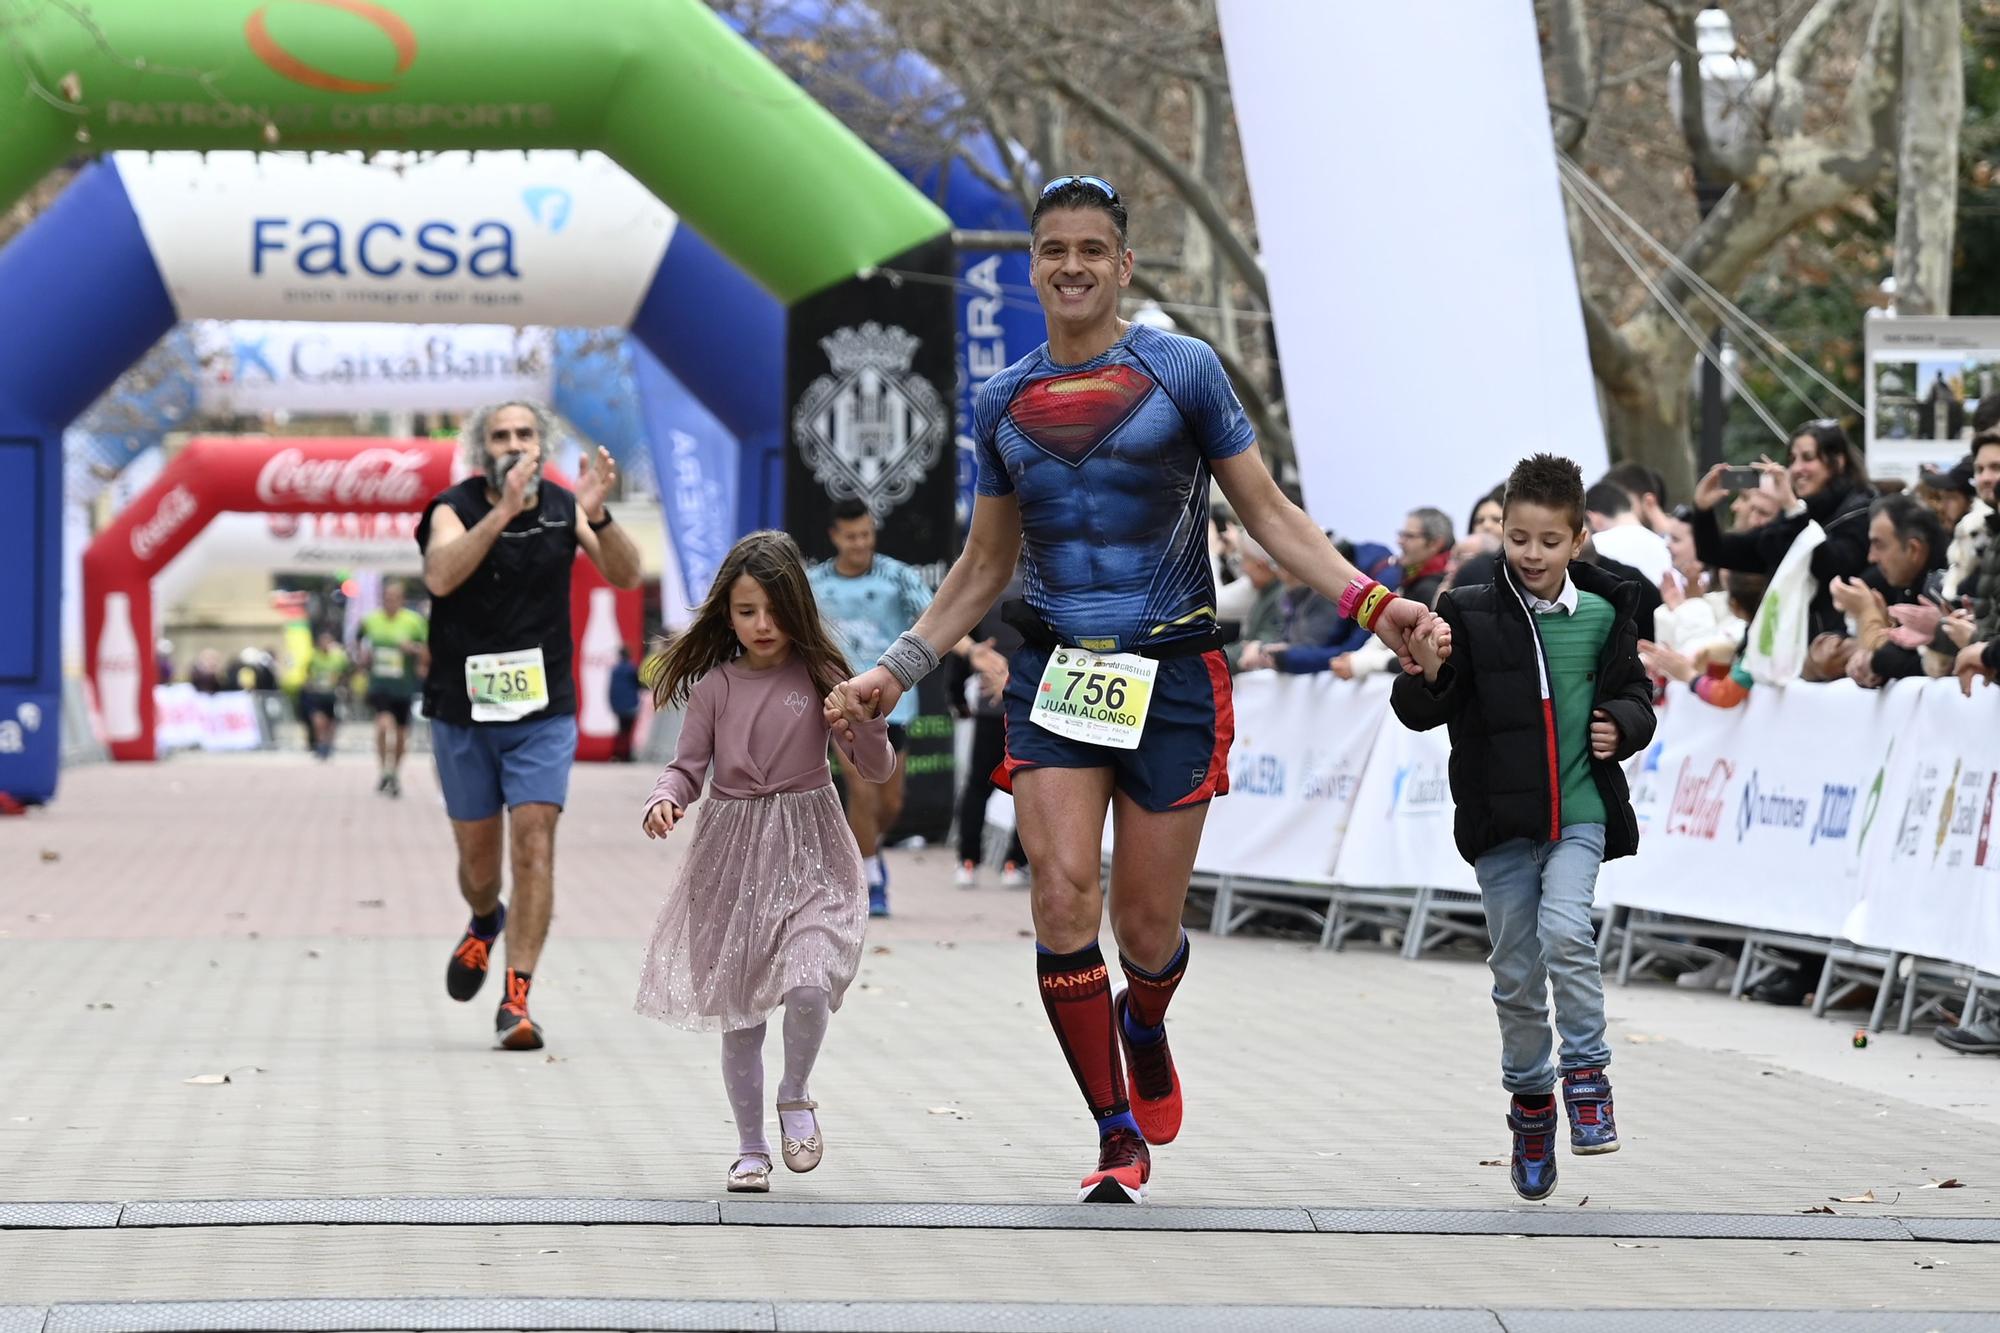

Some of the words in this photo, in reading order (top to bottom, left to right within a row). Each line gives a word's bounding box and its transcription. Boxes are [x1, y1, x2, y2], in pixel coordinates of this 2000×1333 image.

[106, 101, 313, 127] PATRONAT
[256, 448, 431, 505] Coca-Cola
[483, 670, 528, 694] 736
[1064, 671, 1127, 711] 756
[1041, 699, 1077, 716] JUAN
[1080, 706, 1136, 727] ALONSO
